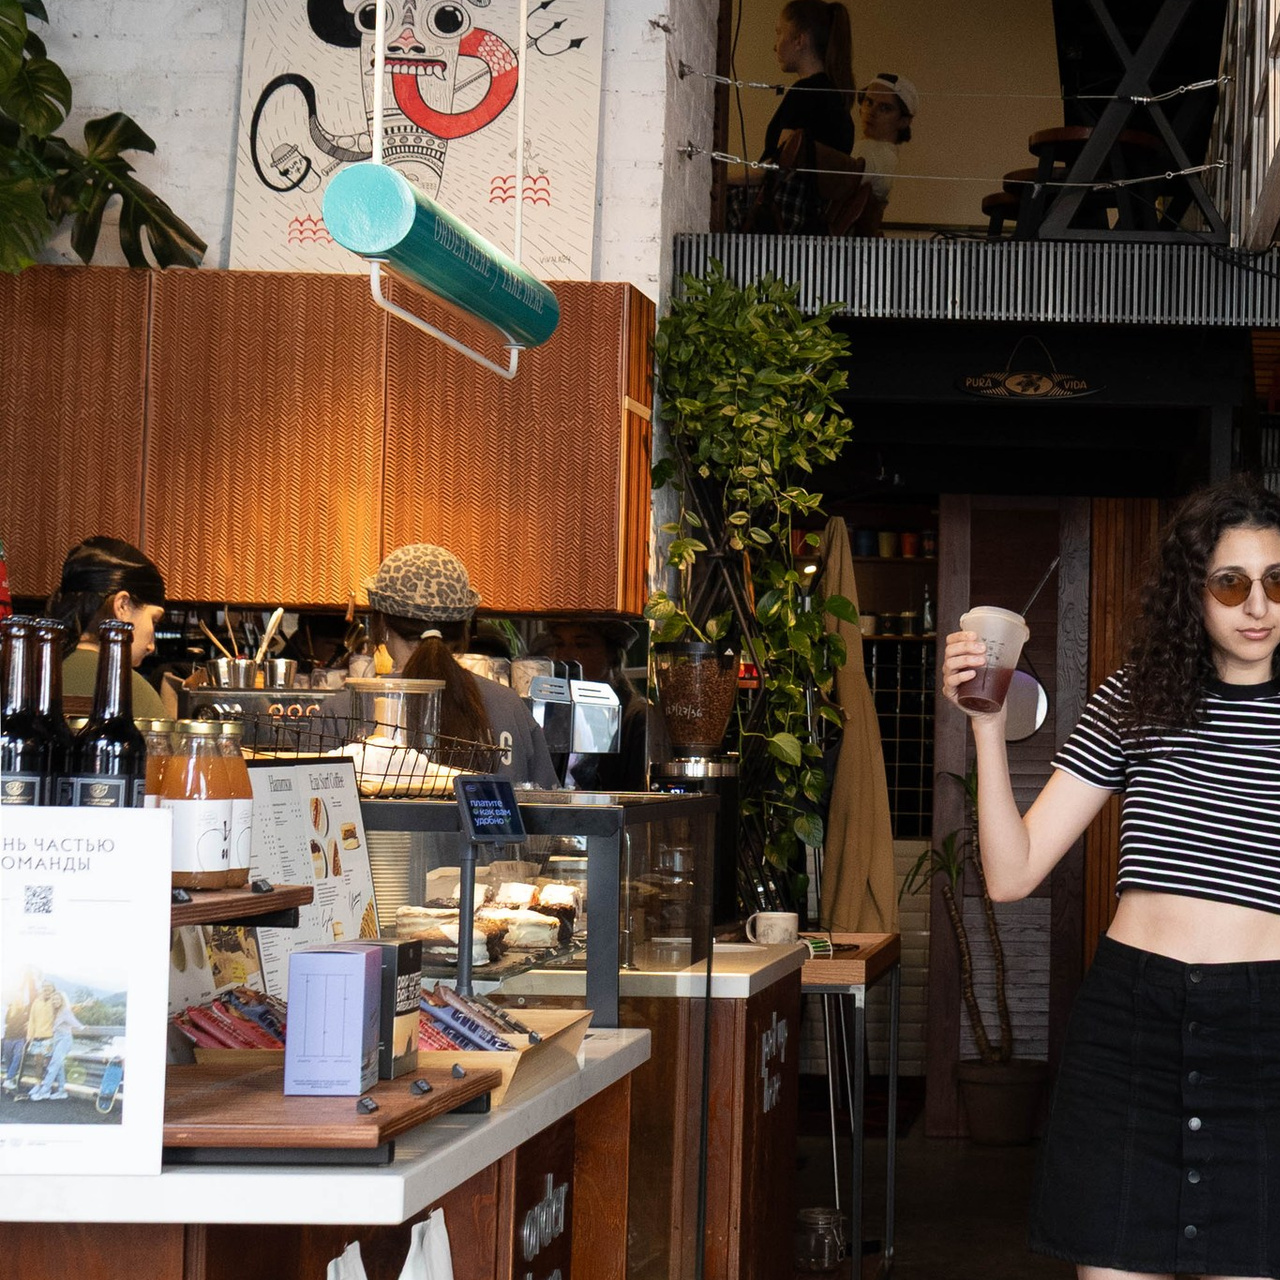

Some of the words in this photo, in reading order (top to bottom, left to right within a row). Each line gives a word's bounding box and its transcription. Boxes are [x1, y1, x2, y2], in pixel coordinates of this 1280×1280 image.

[434, 216, 465, 260] ORDER
[466, 240, 491, 278] HERE
[523, 281, 545, 315] HERE
[965, 377, 993, 388] PURA
[1064, 380, 1088, 390] VIDA
[470, 800, 503, 808] платите
[474, 816, 505, 827] удобно
[3, 837, 26, 852] НЬ
[34, 838, 115, 853] ЧАСТЬЮ
[1, 856, 90, 874] ОМАНДЫ
[524, 1173, 569, 1262] order
